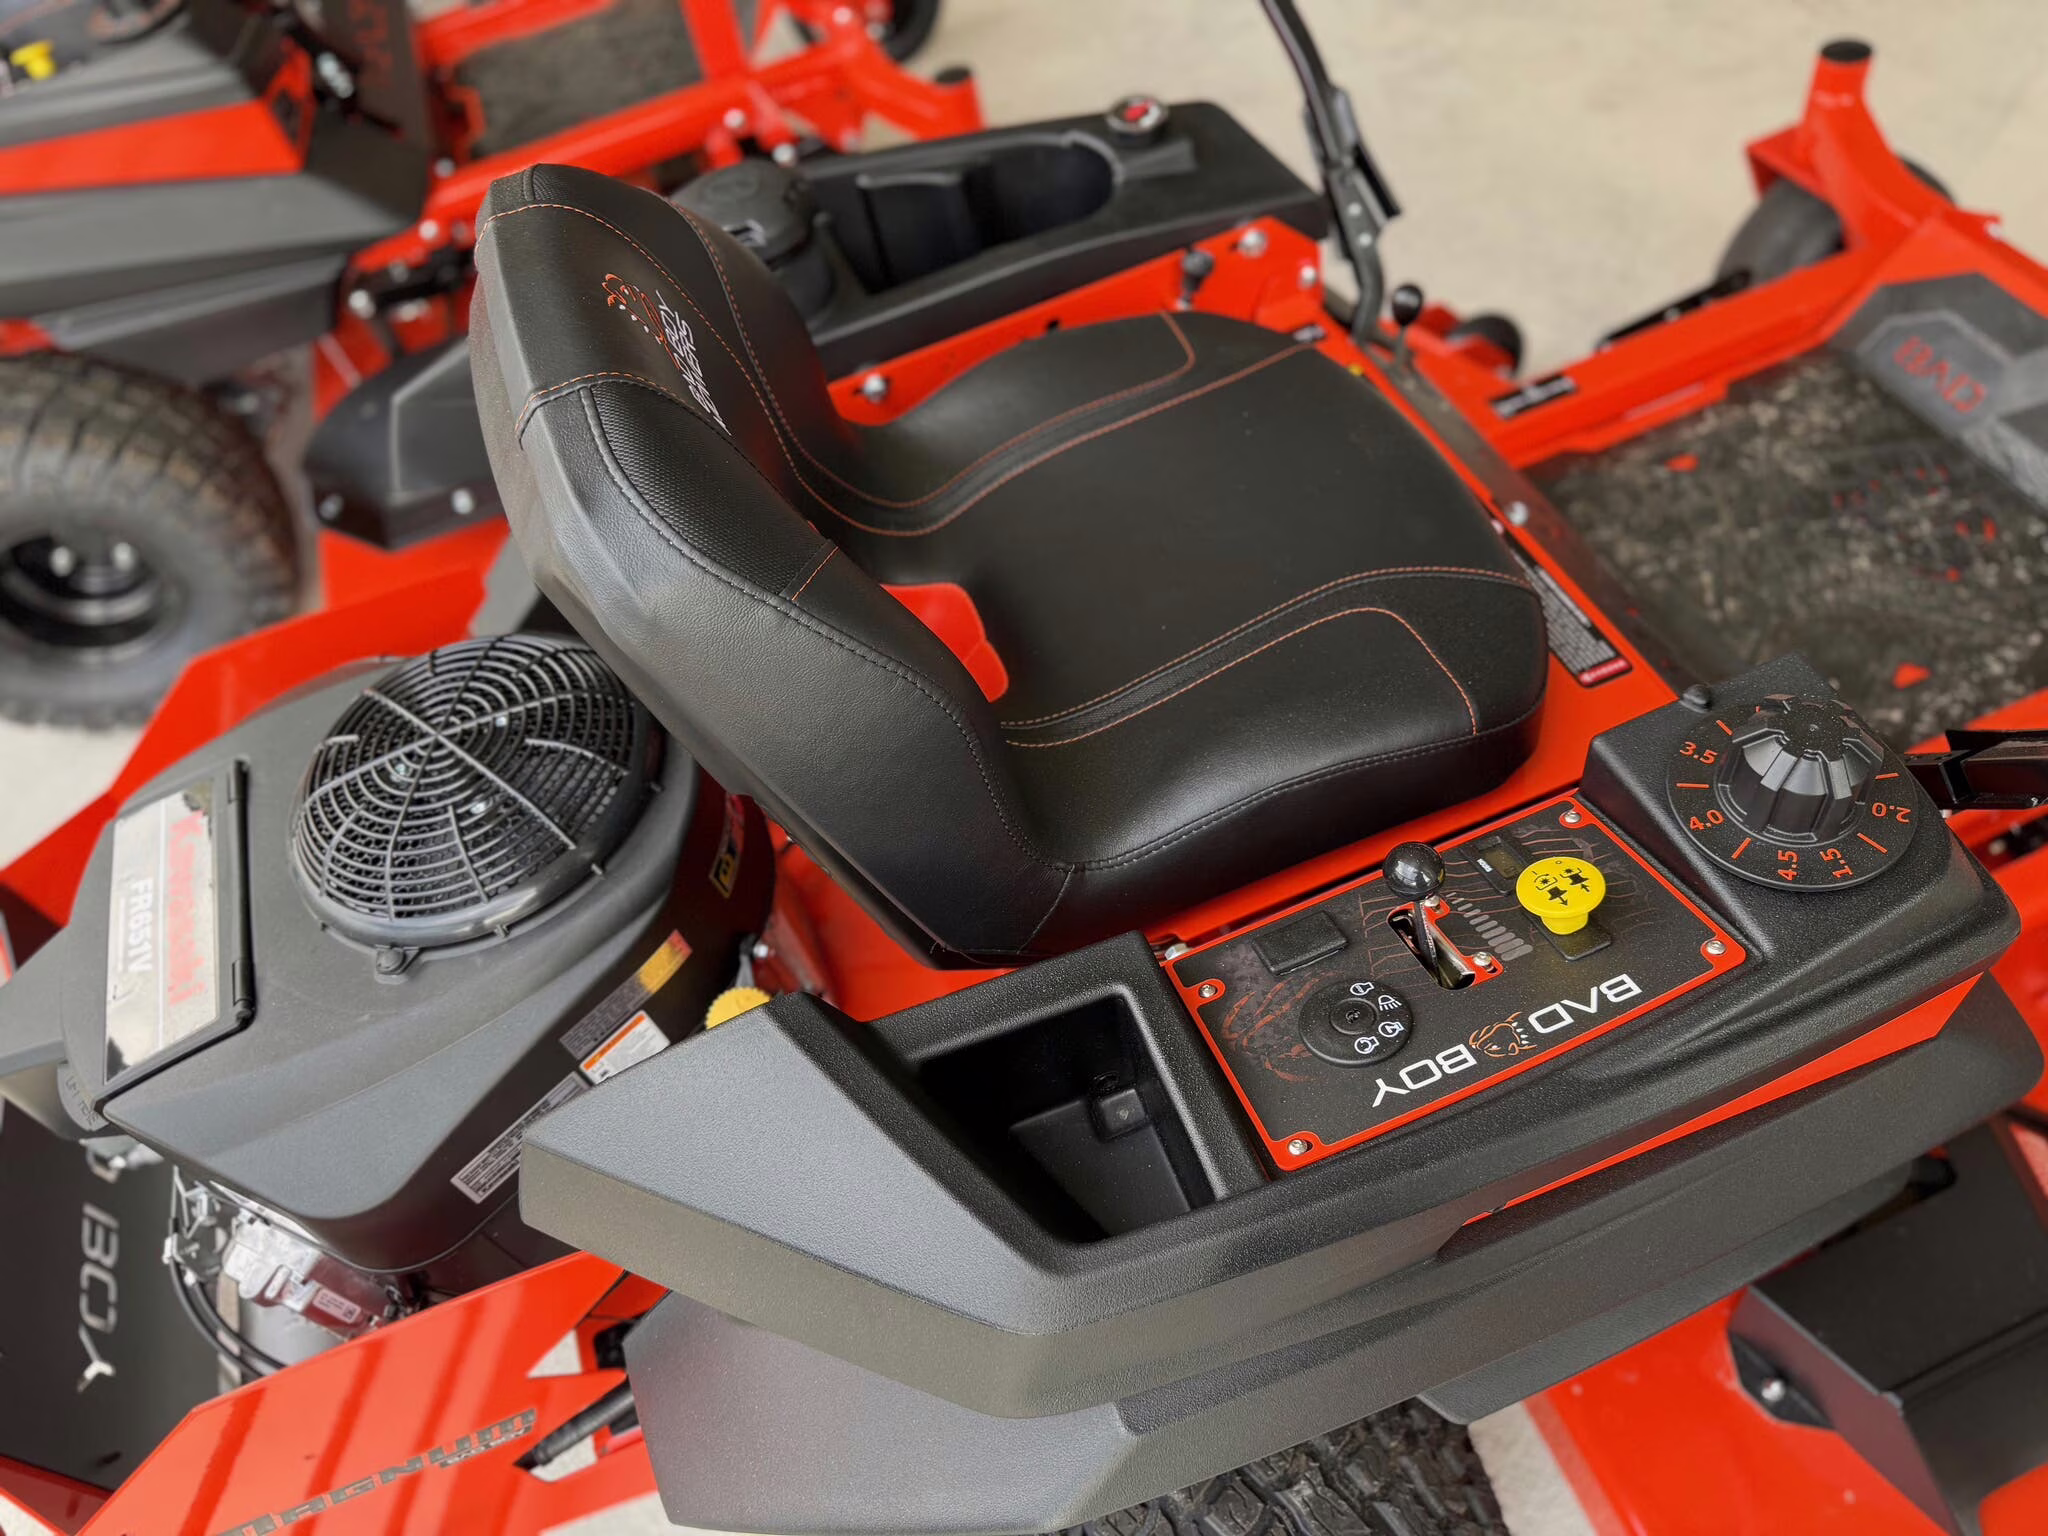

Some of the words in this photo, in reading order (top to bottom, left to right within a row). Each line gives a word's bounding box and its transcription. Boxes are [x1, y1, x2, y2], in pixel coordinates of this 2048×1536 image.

[656, 289, 685, 358] BOY
[1893, 336, 1988, 414] BAD
[1679, 741, 1718, 765] 3.5
[1689, 809, 1725, 831] 4.0
[1871, 801, 1912, 823] 2.0
[1777, 850, 1799, 881] 4.5
[1819, 847, 1854, 879] 1.5
[127, 876, 154, 973] FR651V
[168, 808, 206, 1006] Kawasaki
[1528, 973, 1642, 1034] BAD
[1372, 1043, 1477, 1108] BOY
[79, 1202, 120, 1393] BOY
